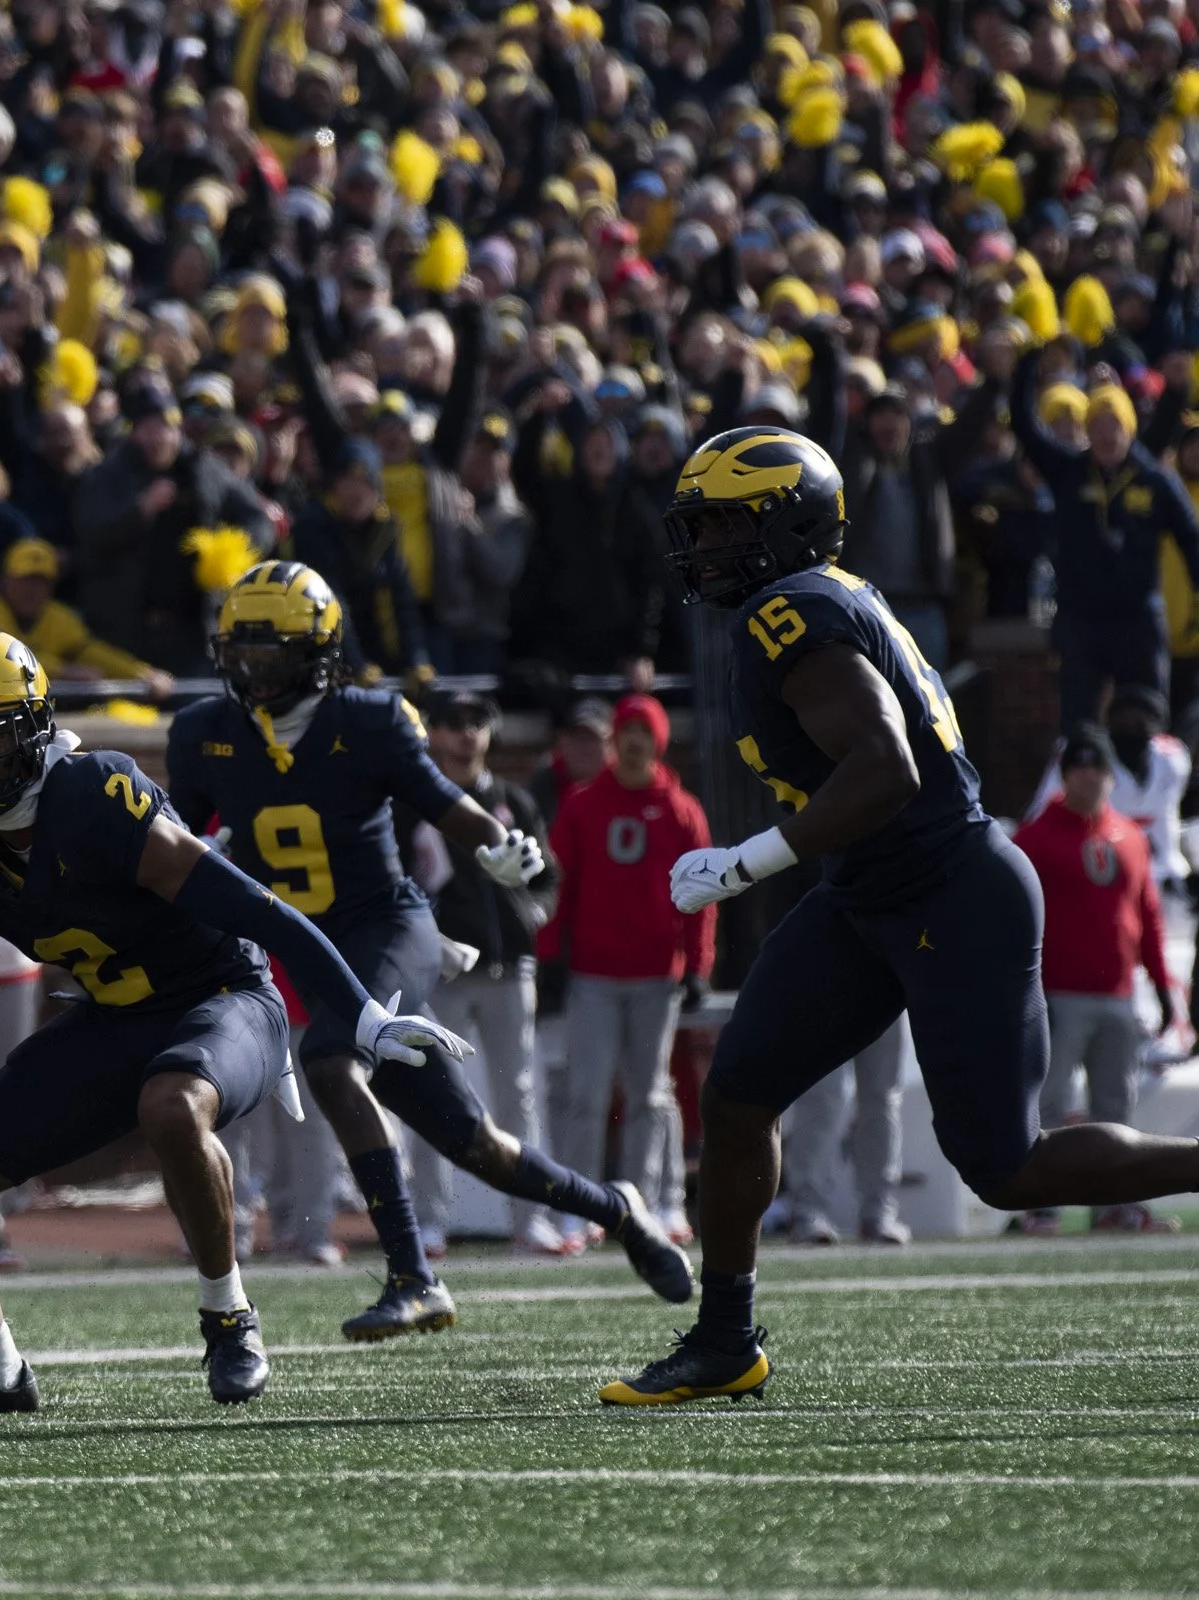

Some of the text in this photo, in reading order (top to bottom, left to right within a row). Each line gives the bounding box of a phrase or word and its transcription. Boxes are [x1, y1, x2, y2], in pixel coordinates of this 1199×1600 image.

[747, 596, 807, 662] 15
[104, 772, 152, 821] 2
[253, 804, 337, 916] 9
[33, 927, 156, 1007] 2
